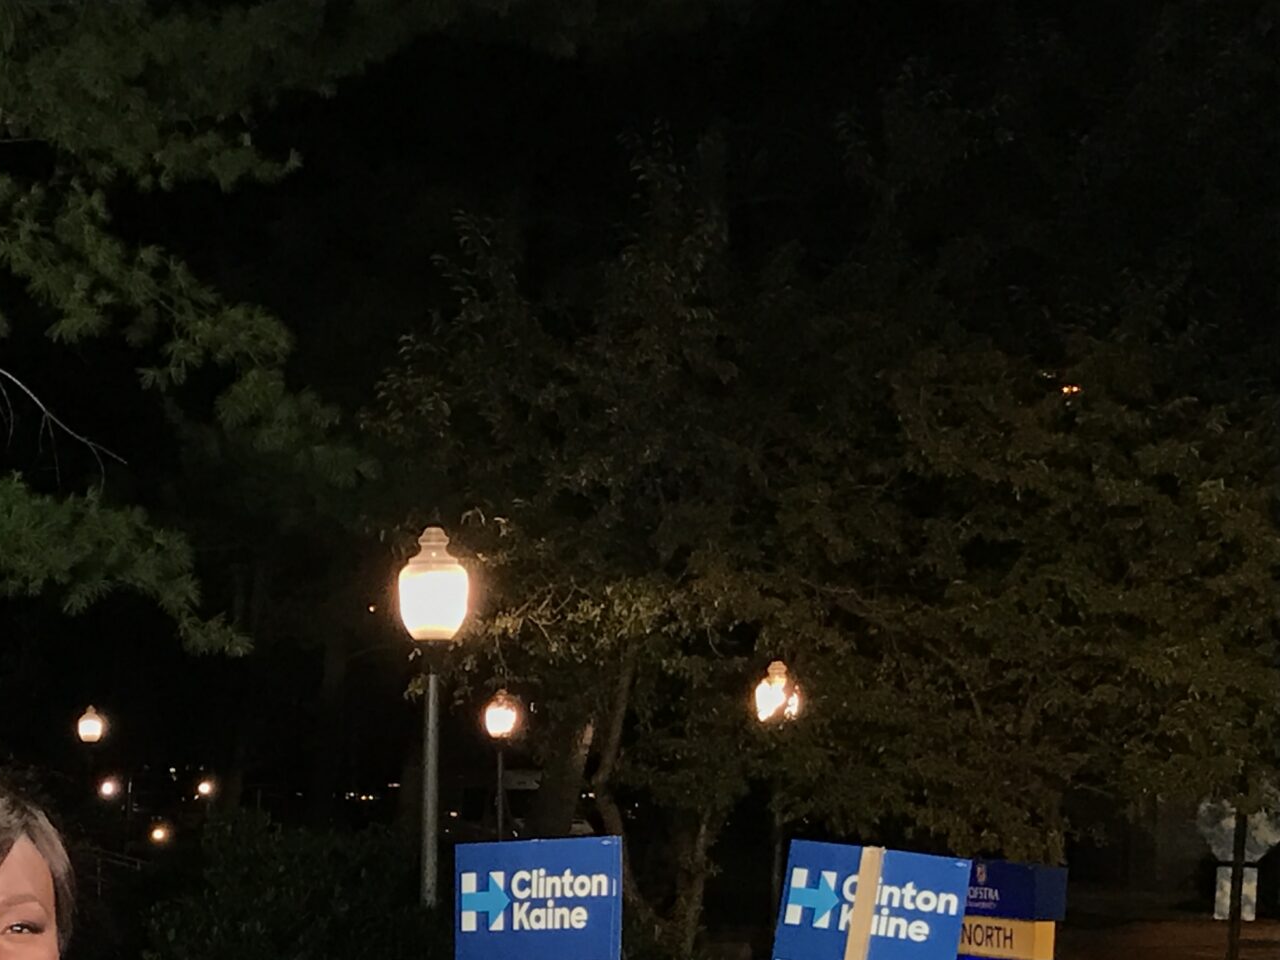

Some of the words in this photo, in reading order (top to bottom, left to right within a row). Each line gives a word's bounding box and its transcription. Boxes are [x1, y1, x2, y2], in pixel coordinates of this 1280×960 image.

[511, 868, 608, 899] Clinton
[842, 874, 958, 916] Cinton
[968, 886, 1000, 901] OFSTRA
[513, 900, 588, 930] Kaine
[961, 923, 1014, 949] NORTH
